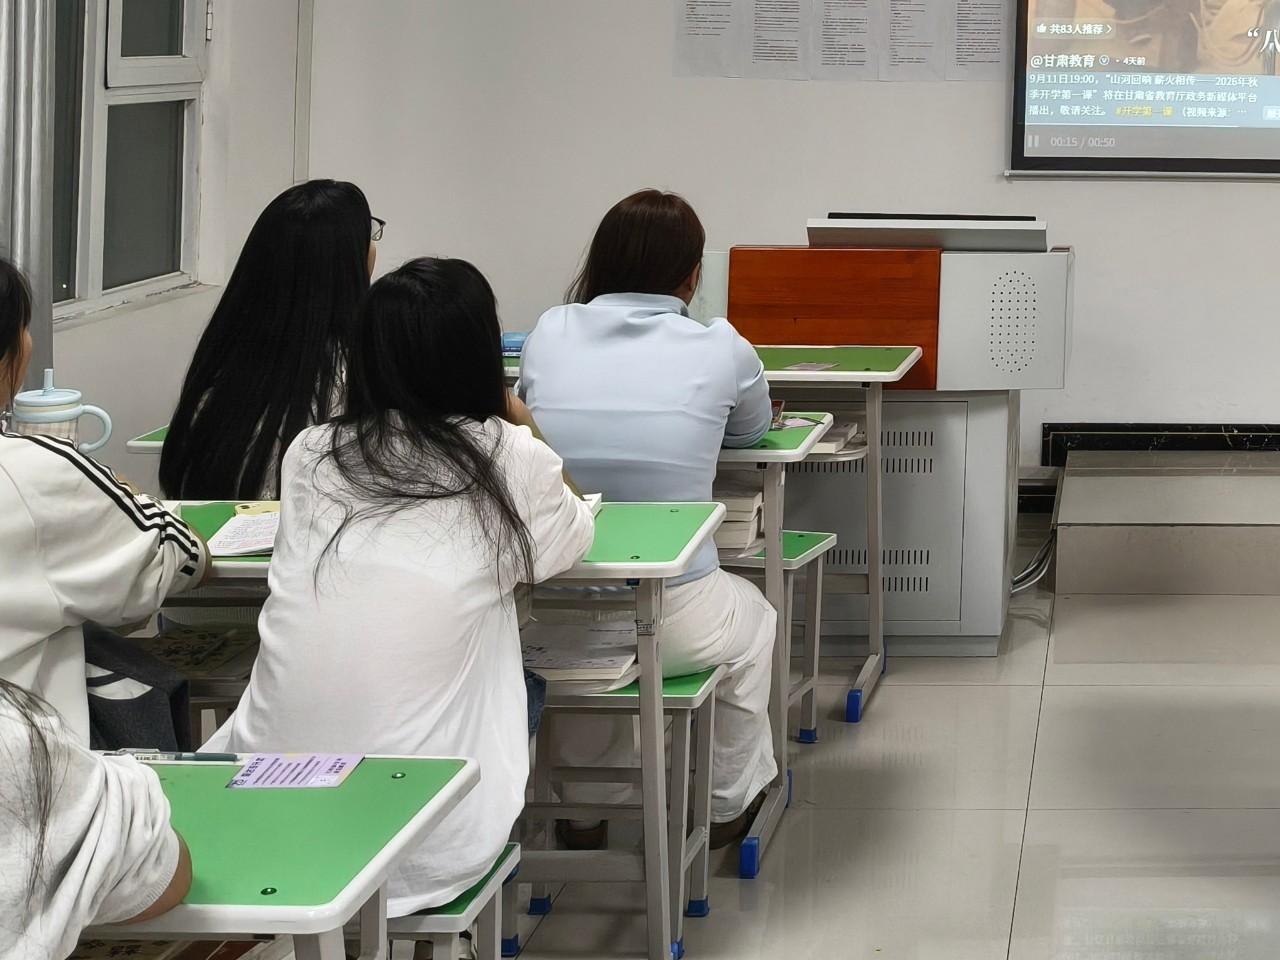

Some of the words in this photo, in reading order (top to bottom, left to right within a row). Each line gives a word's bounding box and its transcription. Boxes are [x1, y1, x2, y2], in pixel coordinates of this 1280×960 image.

[1049, 24, 1104, 36] 共83人推荐
[1030, 54, 1096, 68] @甘肃教育
[1050, 137, 1078, 148] 00:15
[1088, 138, 1116, 149] 00:50
